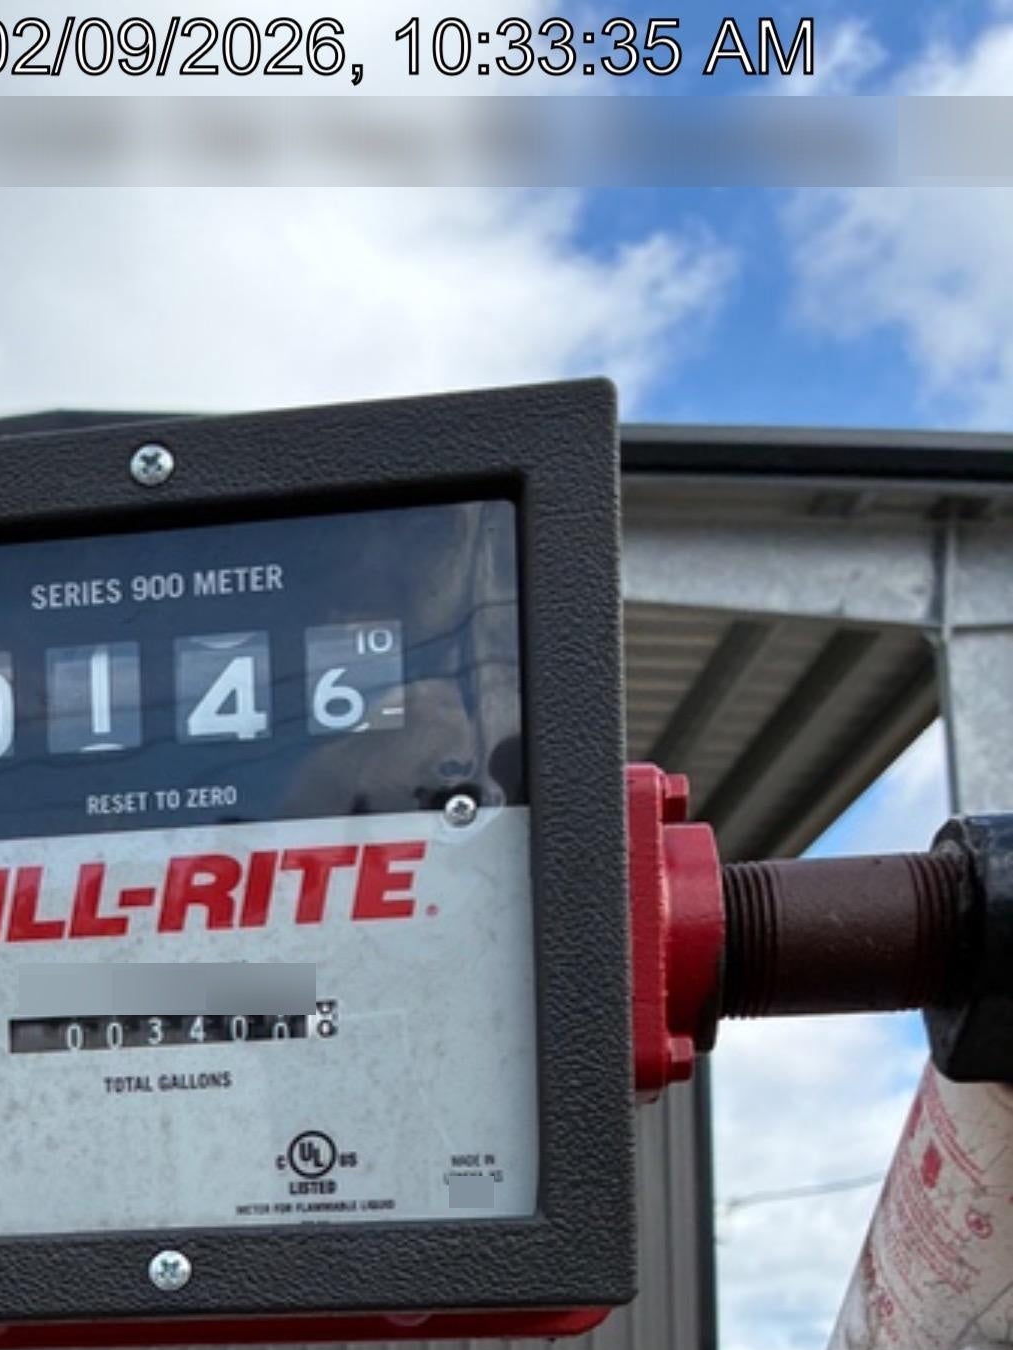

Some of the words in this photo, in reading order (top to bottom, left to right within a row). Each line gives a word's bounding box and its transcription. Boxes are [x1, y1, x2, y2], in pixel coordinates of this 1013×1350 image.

[30, 578, 124, 610] SERIES
[130, 572, 185, 601] 900
[192, 563, 284, 596] METER
[87, 790, 148, 815] RESET
[154, 788, 180, 811] TO
[186, 784, 237, 809] ZERO
[104, 1076, 154, 1094] TOTAL
[158, 1070, 233, 1091] GALLONS
[289, 1180, 337, 1195] LISTED
